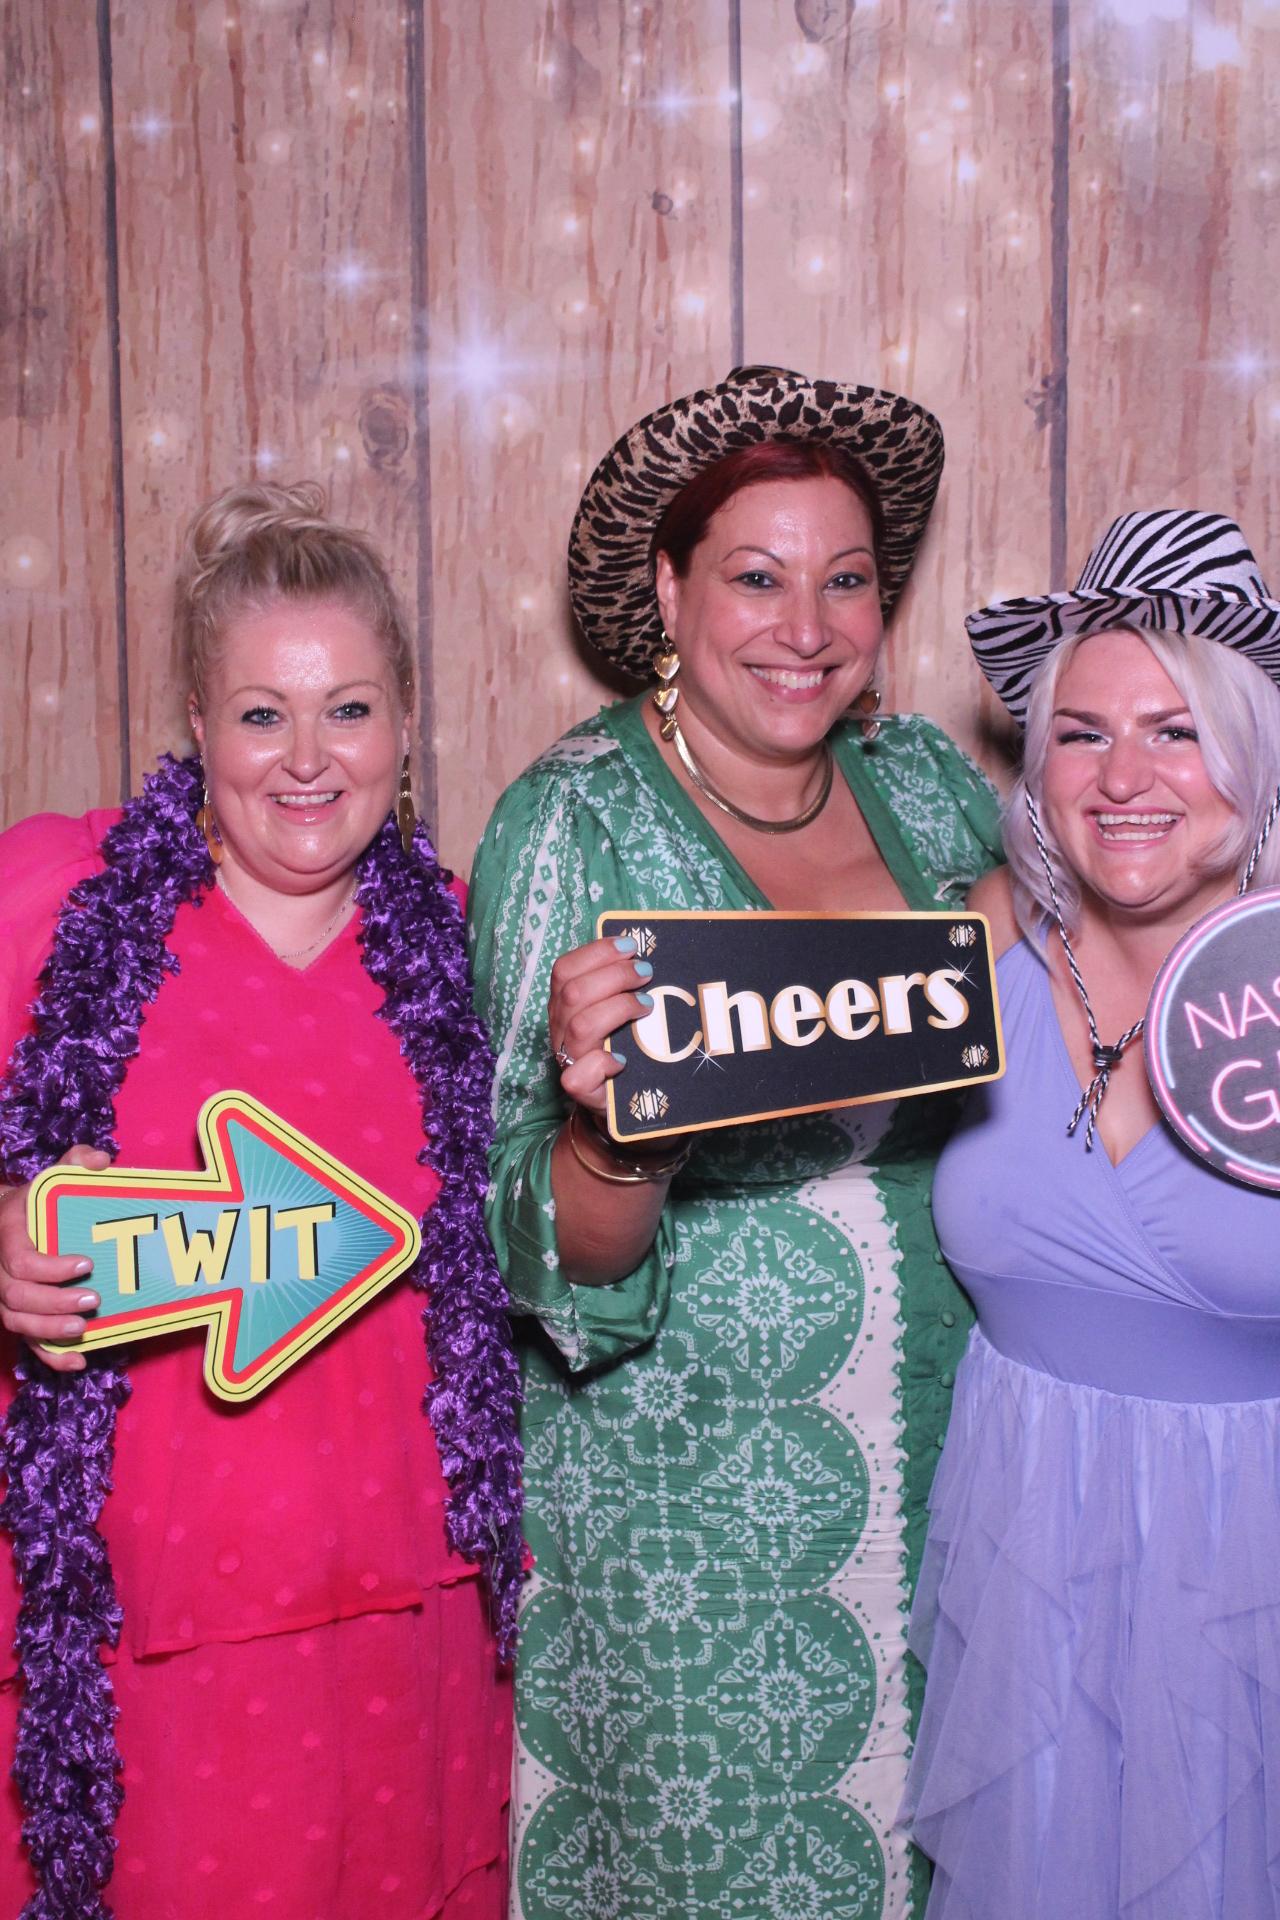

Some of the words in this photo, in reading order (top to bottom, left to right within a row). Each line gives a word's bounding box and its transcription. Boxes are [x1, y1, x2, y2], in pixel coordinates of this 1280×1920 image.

[632, 968, 969, 1063] Cheers
[1184, 975, 1280, 1049] NA
[1211, 1049, 1280, 1131] G
[91, 1201, 336, 1294] TWIT
